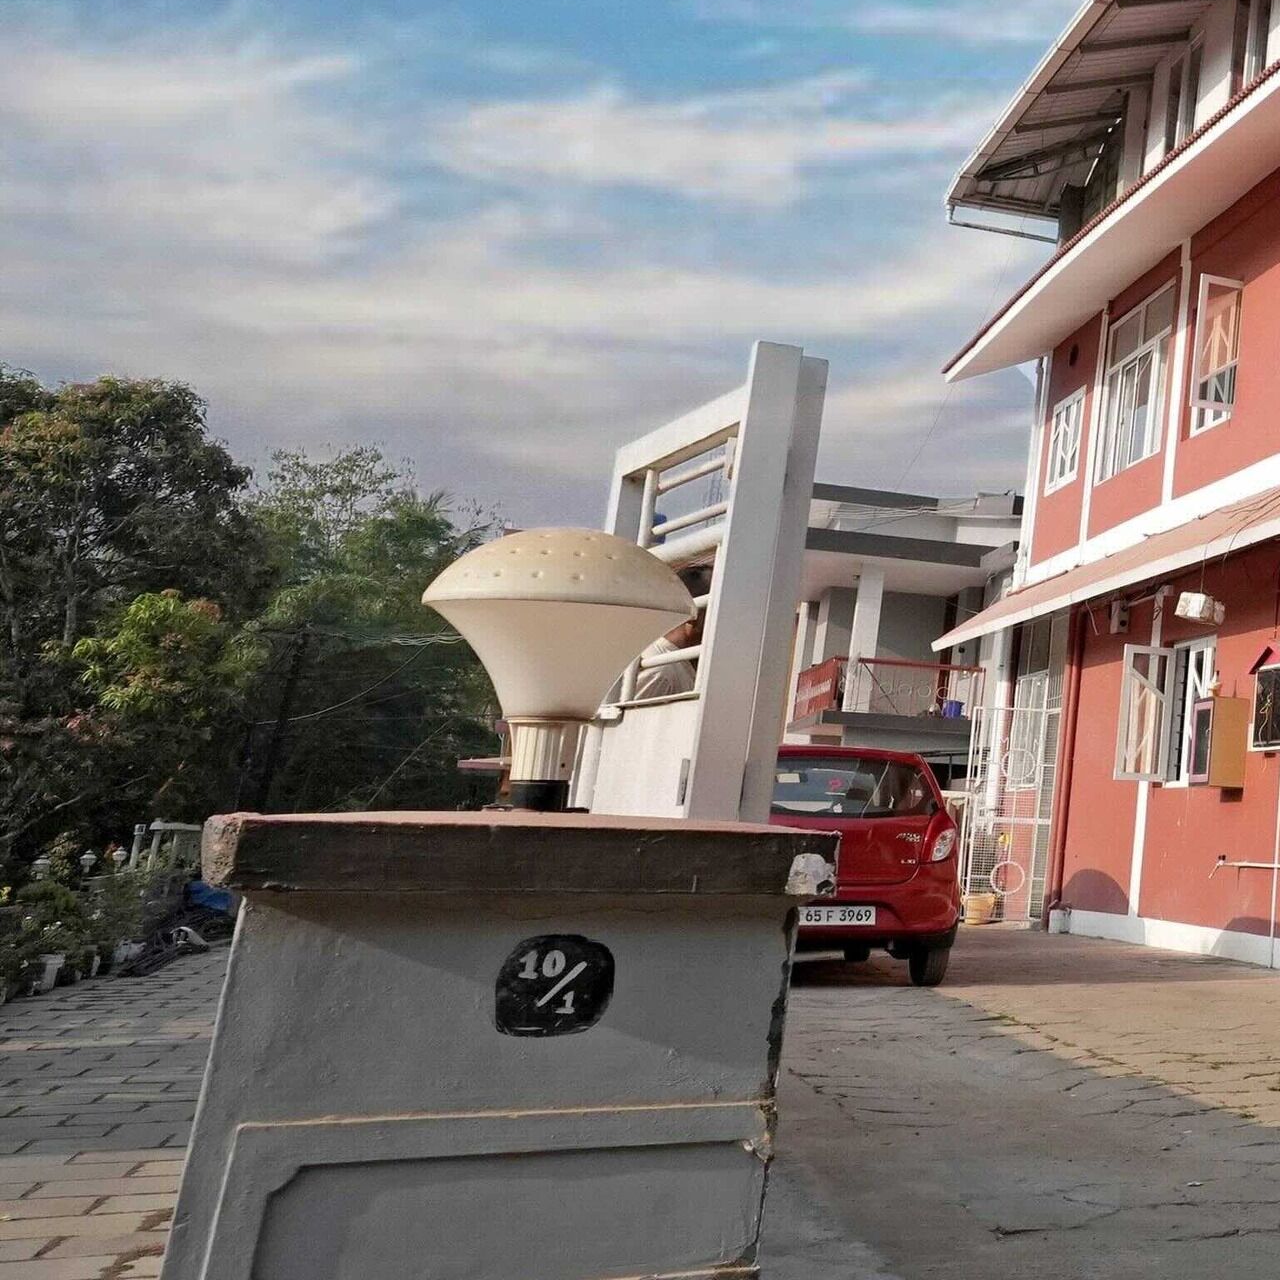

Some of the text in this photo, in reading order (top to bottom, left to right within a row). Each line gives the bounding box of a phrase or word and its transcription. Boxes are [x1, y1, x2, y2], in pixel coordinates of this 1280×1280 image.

[805, 909, 873, 922] 65 F 3969
